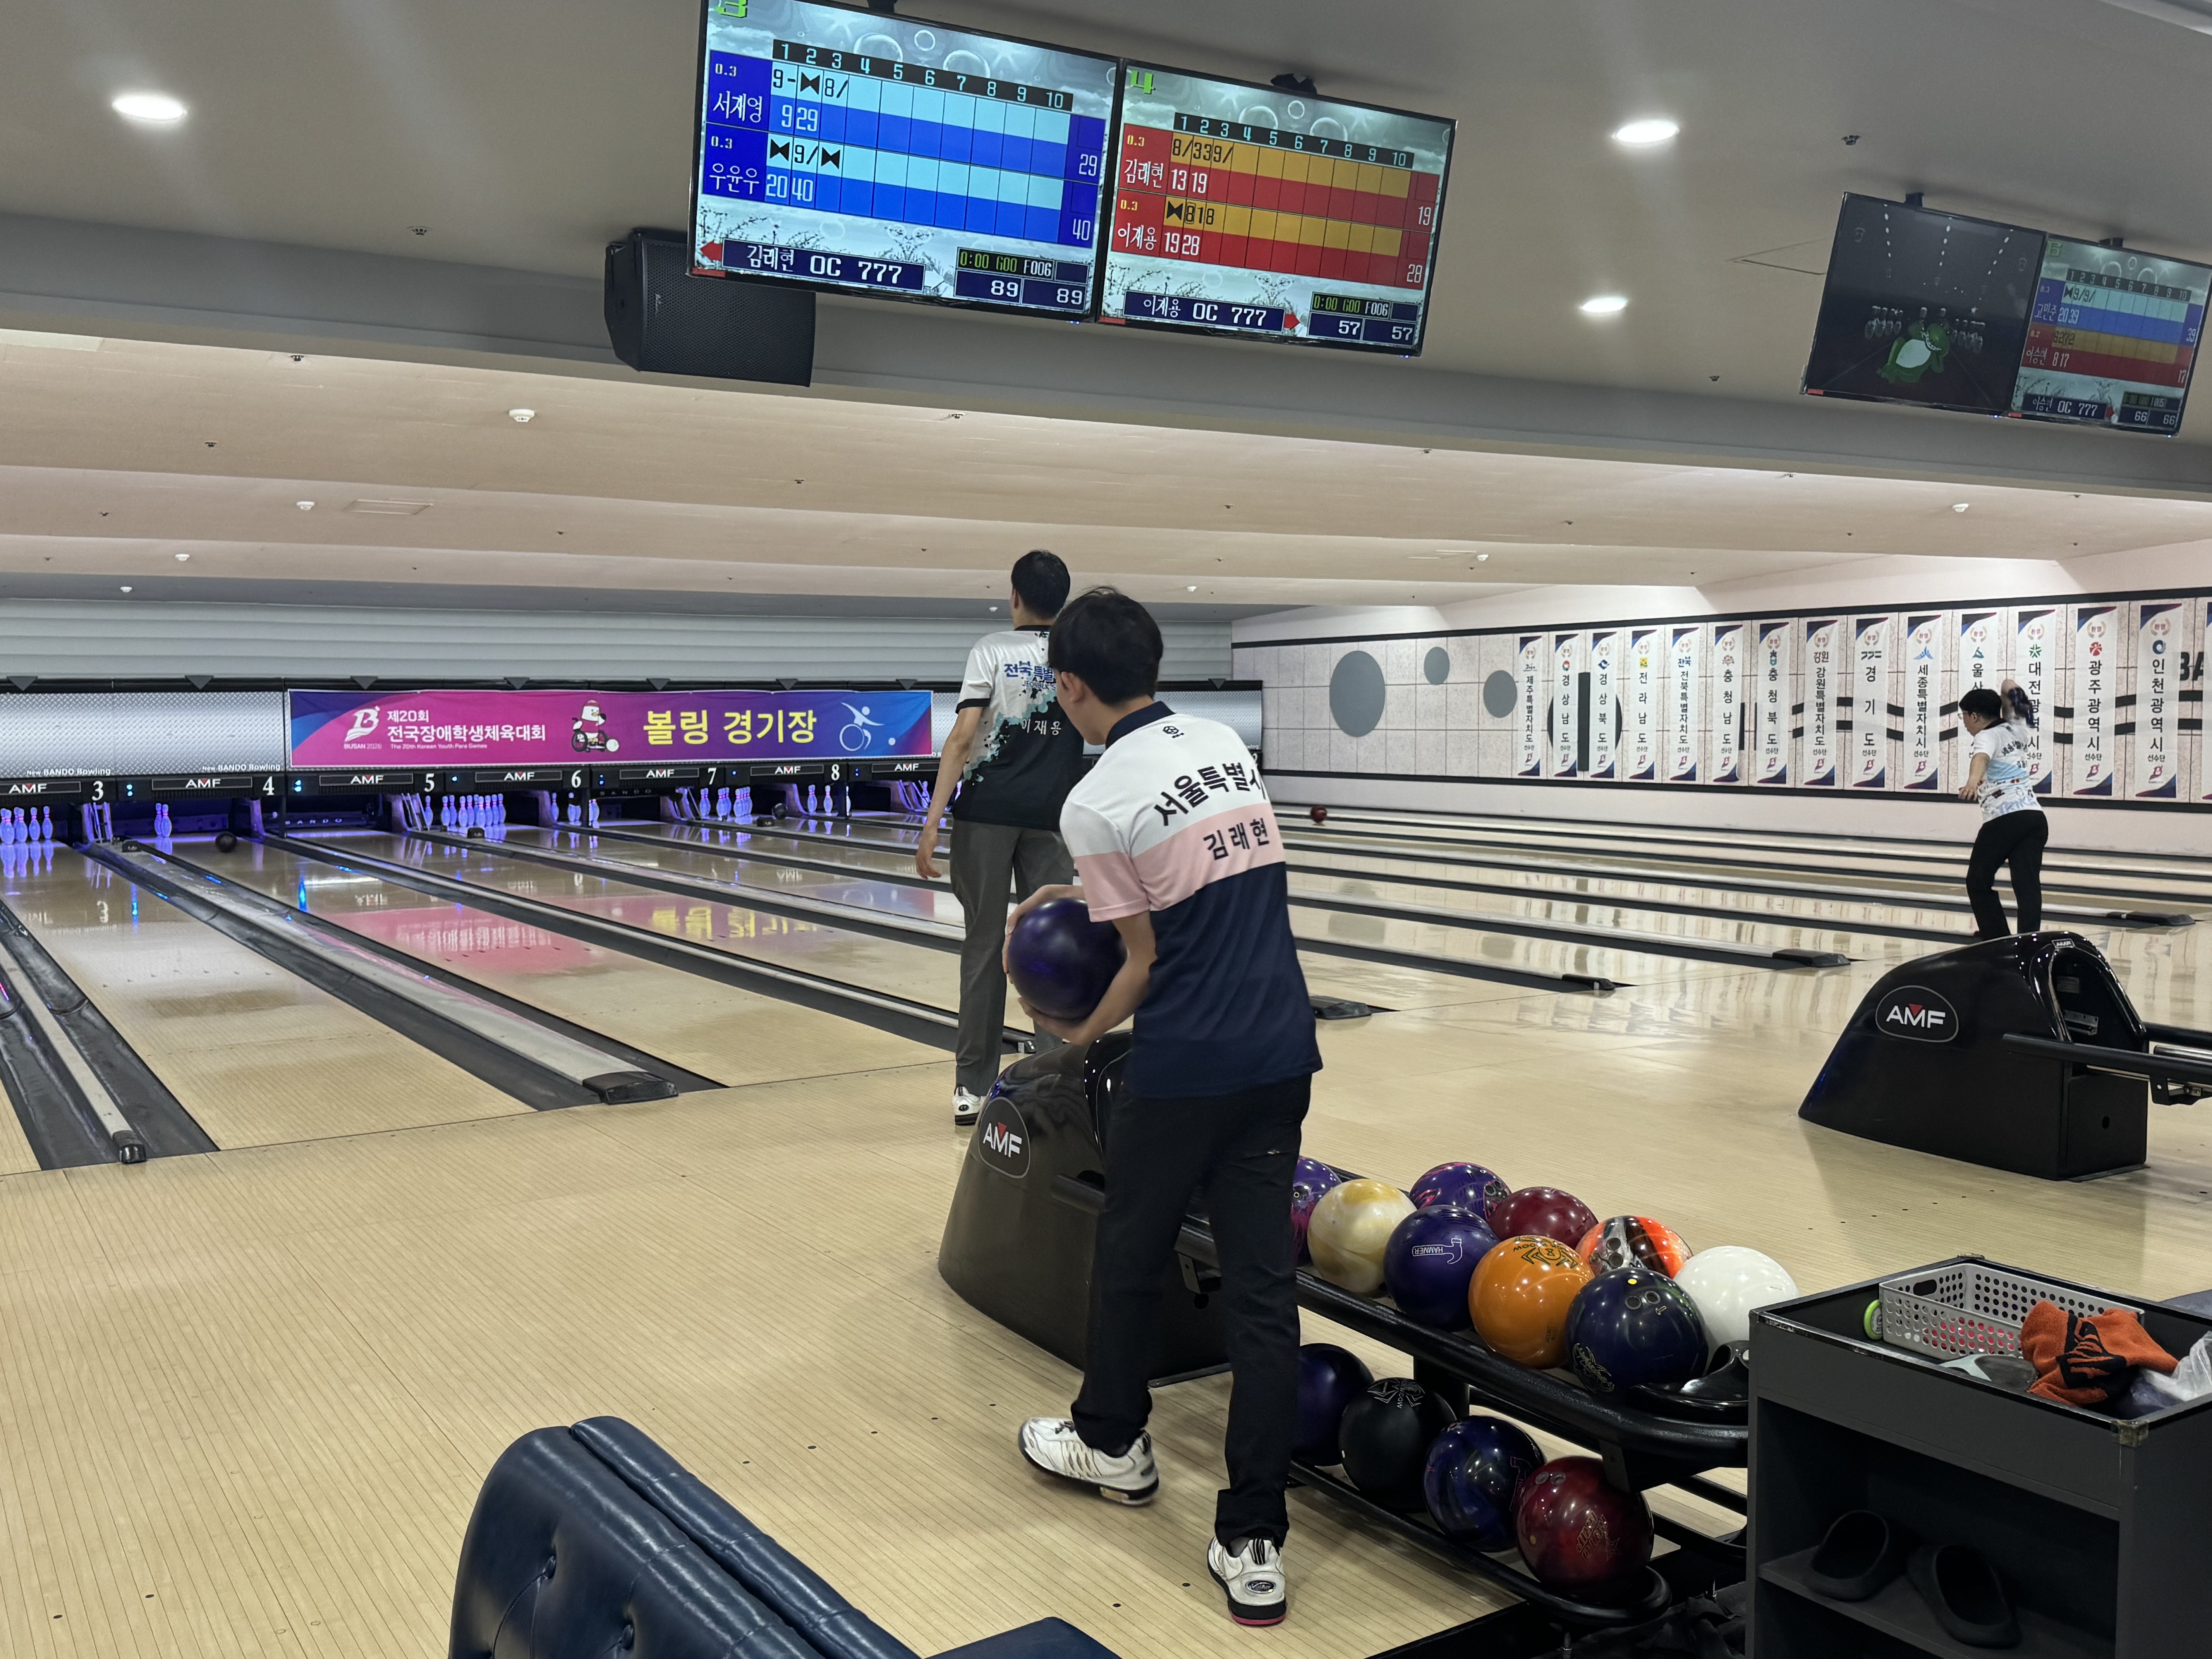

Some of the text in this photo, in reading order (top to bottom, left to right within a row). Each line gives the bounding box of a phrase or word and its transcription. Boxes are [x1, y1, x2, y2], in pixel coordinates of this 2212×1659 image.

[715, 64, 736, 77] 0.3
[781, 44, 1063, 108] 1 2 3 4 5 6 7 8 9 10
[1130, 70, 1156, 94] 4
[781, 105, 792, 127] 9
[796, 107, 818, 132] 29
[711, 136, 732, 149] 0.3
[1127, 135, 1144, 146] 0.3
[1180, 117, 1406, 167] 1 2 3 4 5 6 7 8 9 10
[1078, 153, 1097, 177] 29
[709, 163, 813, 202] 우윤우 20 40
[1125, 159, 1207, 194] 김래현 13 19
[1120, 199, 1138, 211] 0.3
[1418, 206, 1431, 226] 19
[1072, 218, 1091, 241] 40
[1164, 232, 1180, 253] 19
[1182, 235, 1200, 256] 28
[746, 244, 795, 273] 김래현
[857, 261, 902, 285] 777
[960, 251, 989, 270] 0:00
[1023, 260, 1052, 277] F006
[1407, 263, 1422, 283] 28
[991, 280, 1083, 305] 89 89
[1231, 306, 1267, 326] 777
[1365, 301, 1388, 317] F006
[1338, 320, 1413, 340] 57 57
[2186, 328, 2197, 342] 39
[2178, 370, 2187, 383] 17
[2078, 403, 2098, 417] 777
[2134, 411, 2176, 425] 66 66
[1525, 676, 1534, 743] 제주특별자치도
[1561, 675, 1570, 744] 경상남도
[1598, 673, 1607, 743] 경상북도
[1637, 672, 1647, 743] 전라남도
[1679, 671, 1688, 744] 전북특별자치도
[1723, 670, 1733, 745] 충청남도
[1767, 669, 1778, 745] 충청북도
[1815, 667, 1826, 746] 강원특별자치도
[1863, 666, 1875, 746] 경기도
[1916, 664, 1928, 748] 세종특별자치시
[2088, 660, 2102, 751] 광주광역시
[2150, 659, 2165, 752] 인천광역시
[387, 709, 429, 723] 제20회
[387, 725, 545, 742] 전국장애학생체육대회
[643, 709, 817, 745] 볼링 경기장
[1022, 719, 1061, 735] 이재용
[249, 763, 280, 771] Bowling
[894, 763, 919, 771] AMF
[2148, 754, 2165, 762] 선수단
[77, 768, 111, 776] Bowling
[350, 775, 384, 784] AMF
[503, 771, 535, 781] AMF
[571, 769, 582, 788] 6
[646, 769, 675, 778] AMF
[707, 768, 717, 785] 7
[775, 766, 801, 775] AMF
[831, 764, 840, 781] 8
[9, 783, 47, 794] AMF
[92, 781, 104, 801] 3
[185, 778, 221, 788] AMF
[263, 776, 275, 795] 4
[424, 773, 435, 792] 5
[1154, 762, 1266, 826] 서울특별시
[1203, 817, 1269, 860] 김래현
[1886, 1004, 1946, 1029] AMF
[983, 1122, 1022, 1158] AMF
